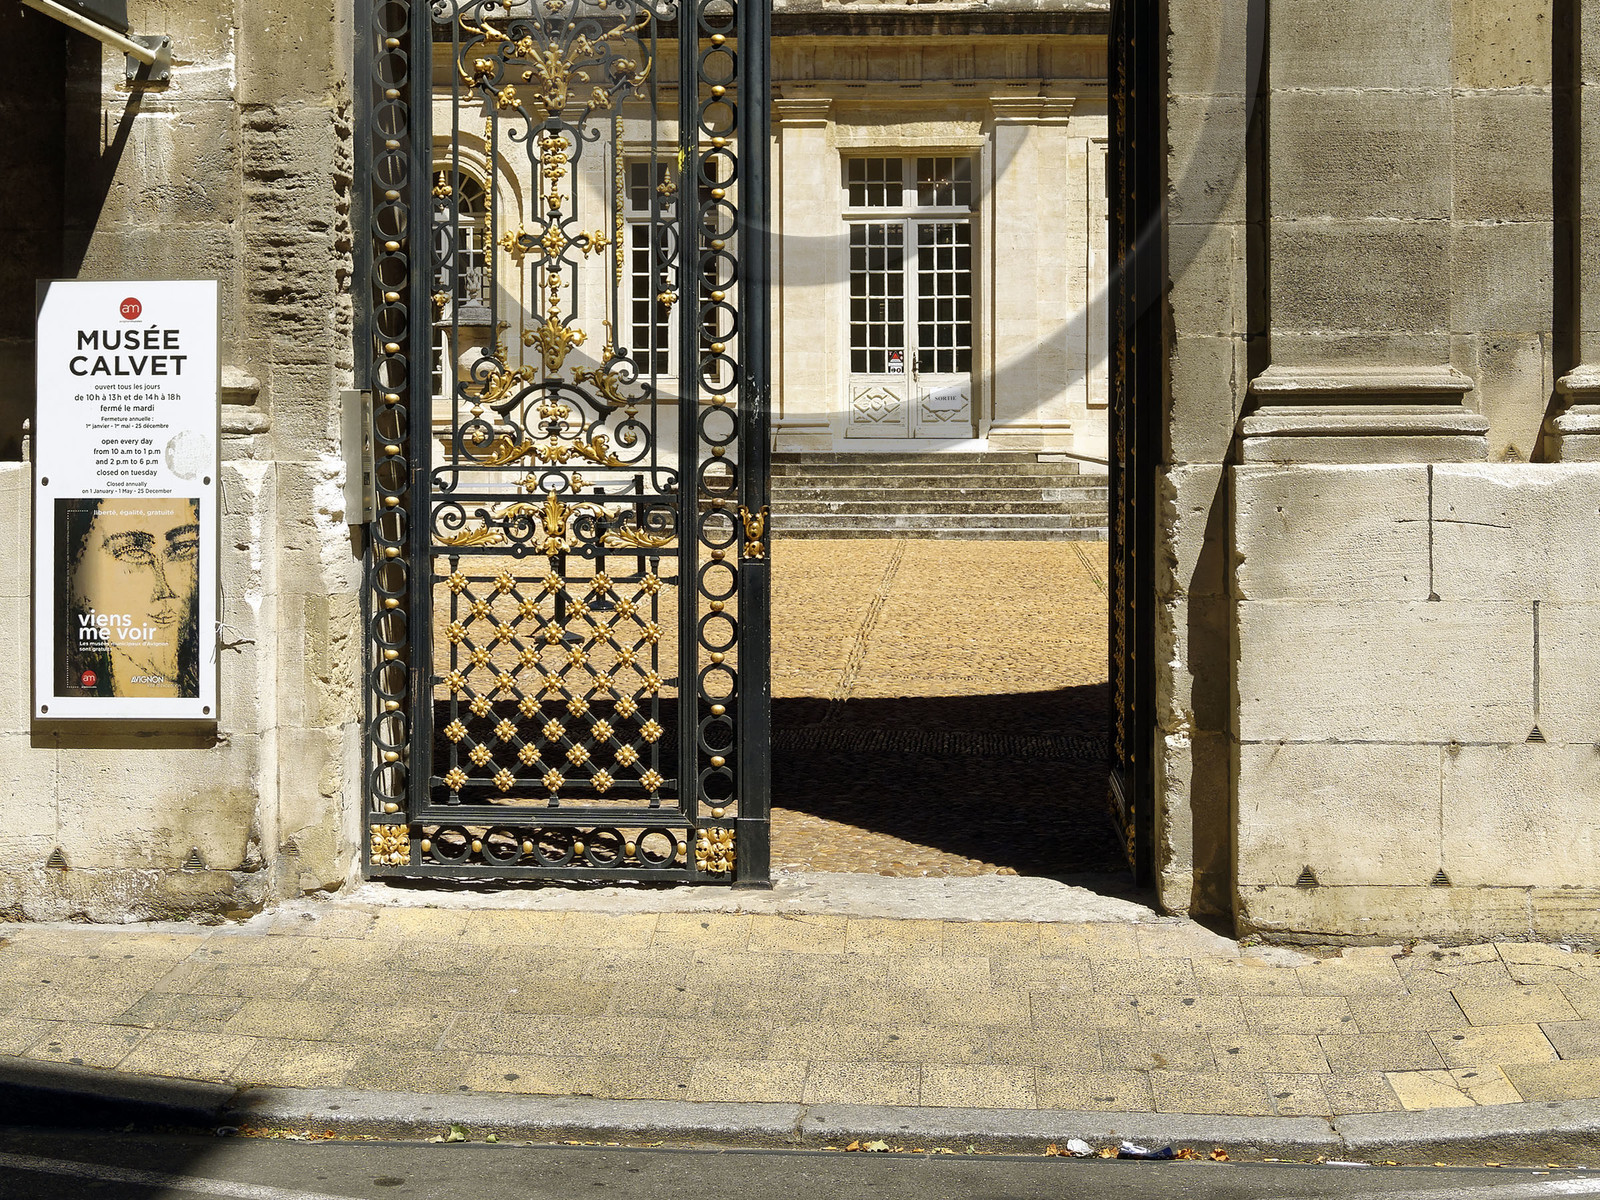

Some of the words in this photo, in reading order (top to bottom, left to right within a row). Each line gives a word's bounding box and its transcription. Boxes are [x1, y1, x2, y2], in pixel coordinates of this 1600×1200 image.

[121, 304, 140, 314] am
[77, 324, 180, 350] MUSÉE
[69, 355, 187, 376] CALVET
[143, 383, 161, 391] jours
[74, 393, 84, 401] de
[101, 393, 107, 401] à
[123, 393, 131, 401] et
[133, 393, 143, 401] de
[160, 393, 166, 401] à
[100, 404, 122, 412] fermé
[124, 404, 131, 412] le
[133, 404, 155, 412] mardi
[78, 608, 132, 627] viens
[79, 627, 111, 640] me
[116, 622, 157, 640] voir
[82, 674, 96, 682] am
[130, 675, 164, 683] AVIGNON
